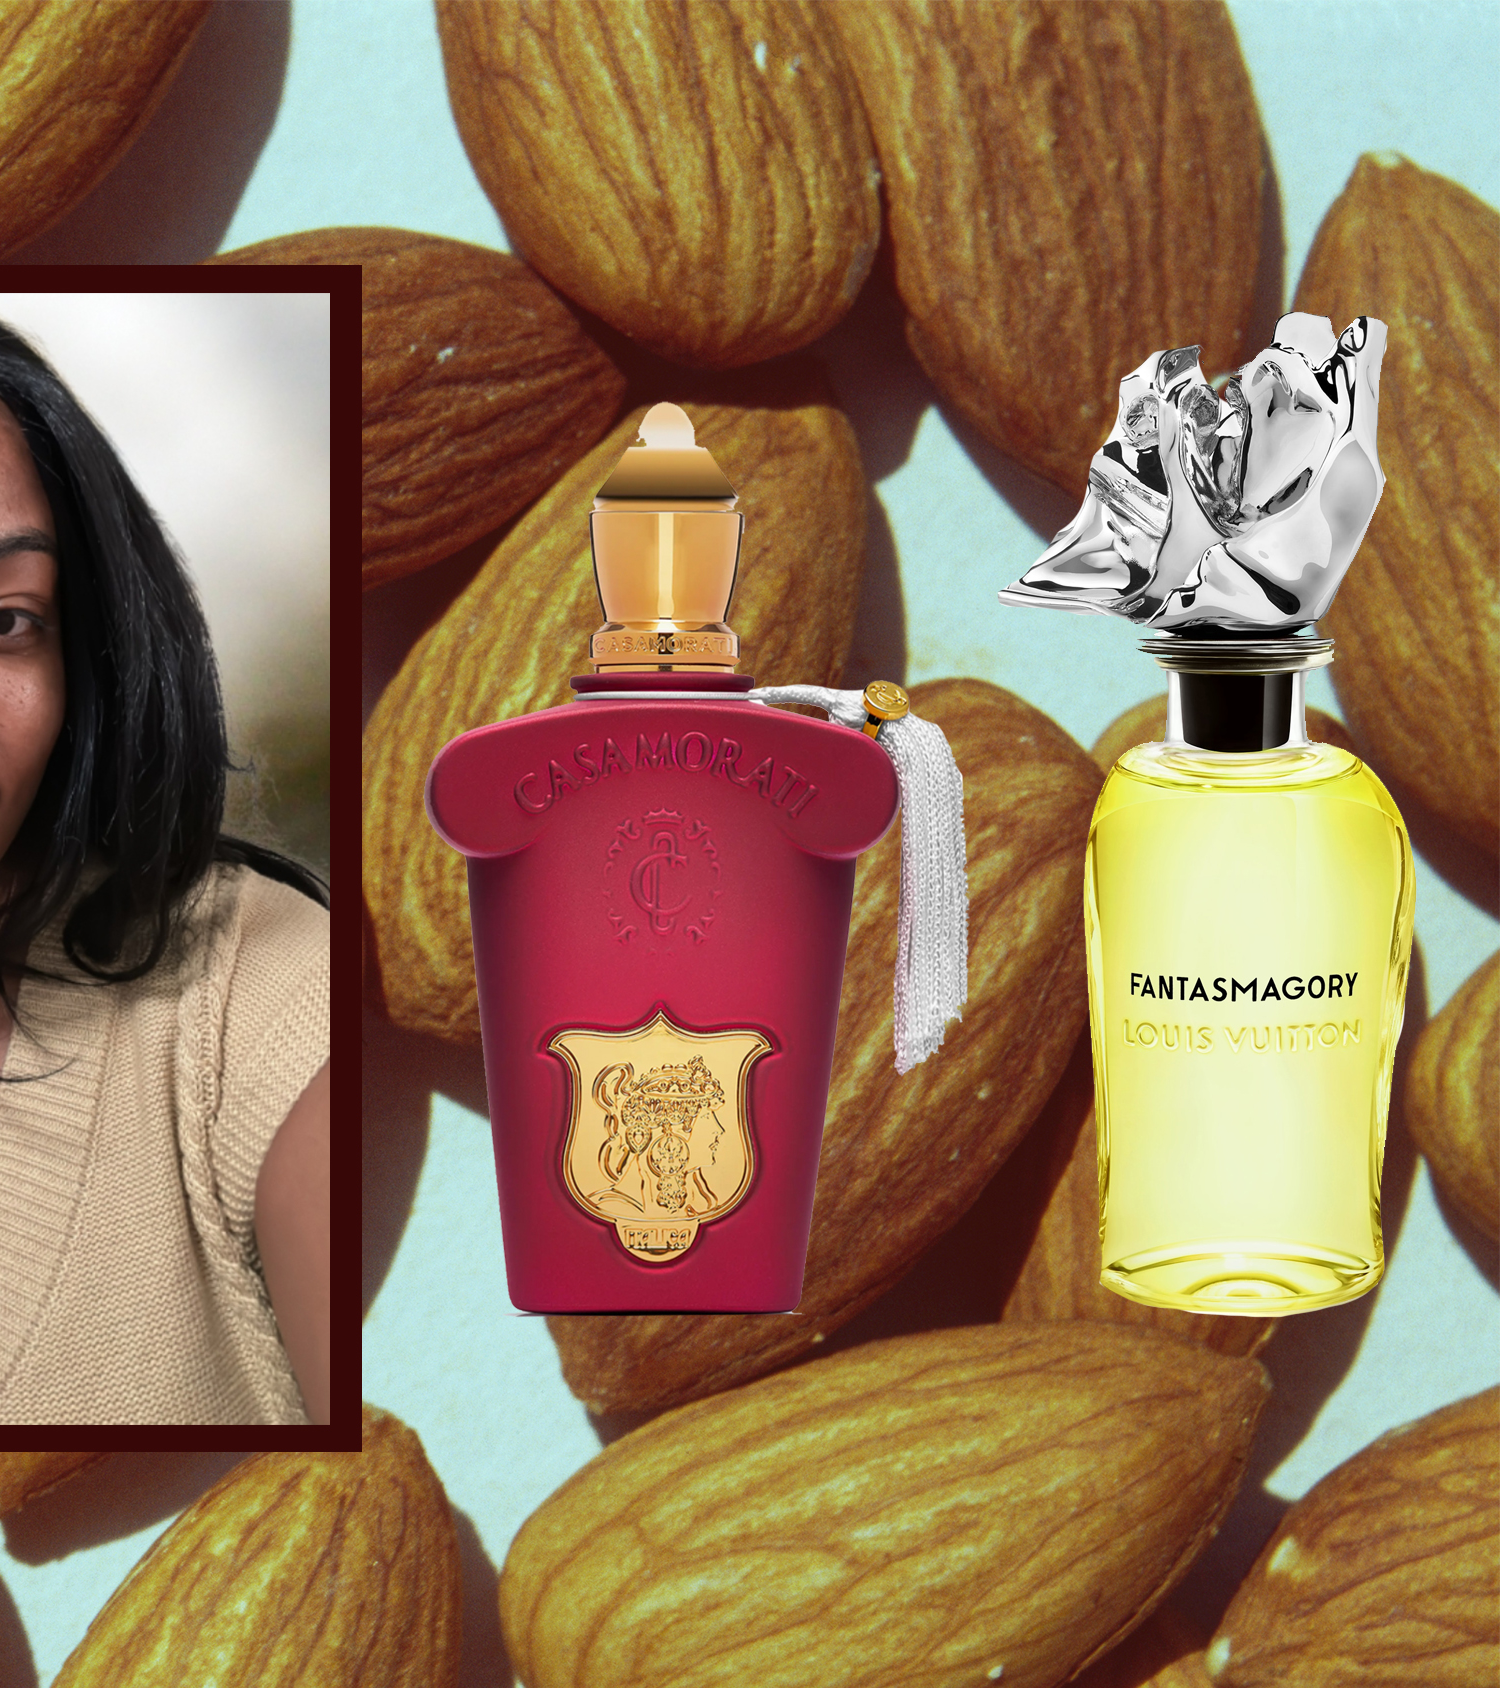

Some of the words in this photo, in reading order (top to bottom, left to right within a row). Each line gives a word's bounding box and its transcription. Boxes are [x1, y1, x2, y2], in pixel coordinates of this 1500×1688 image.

[595, 636, 732, 653] CASAMORATI
[513, 731, 820, 819] CASAMORATI
[1130, 972, 1359, 1002] FANTASMAGORY
[1123, 1019, 1213, 1054] LOUIS
[1223, 1019, 1361, 1054] VUITTON
